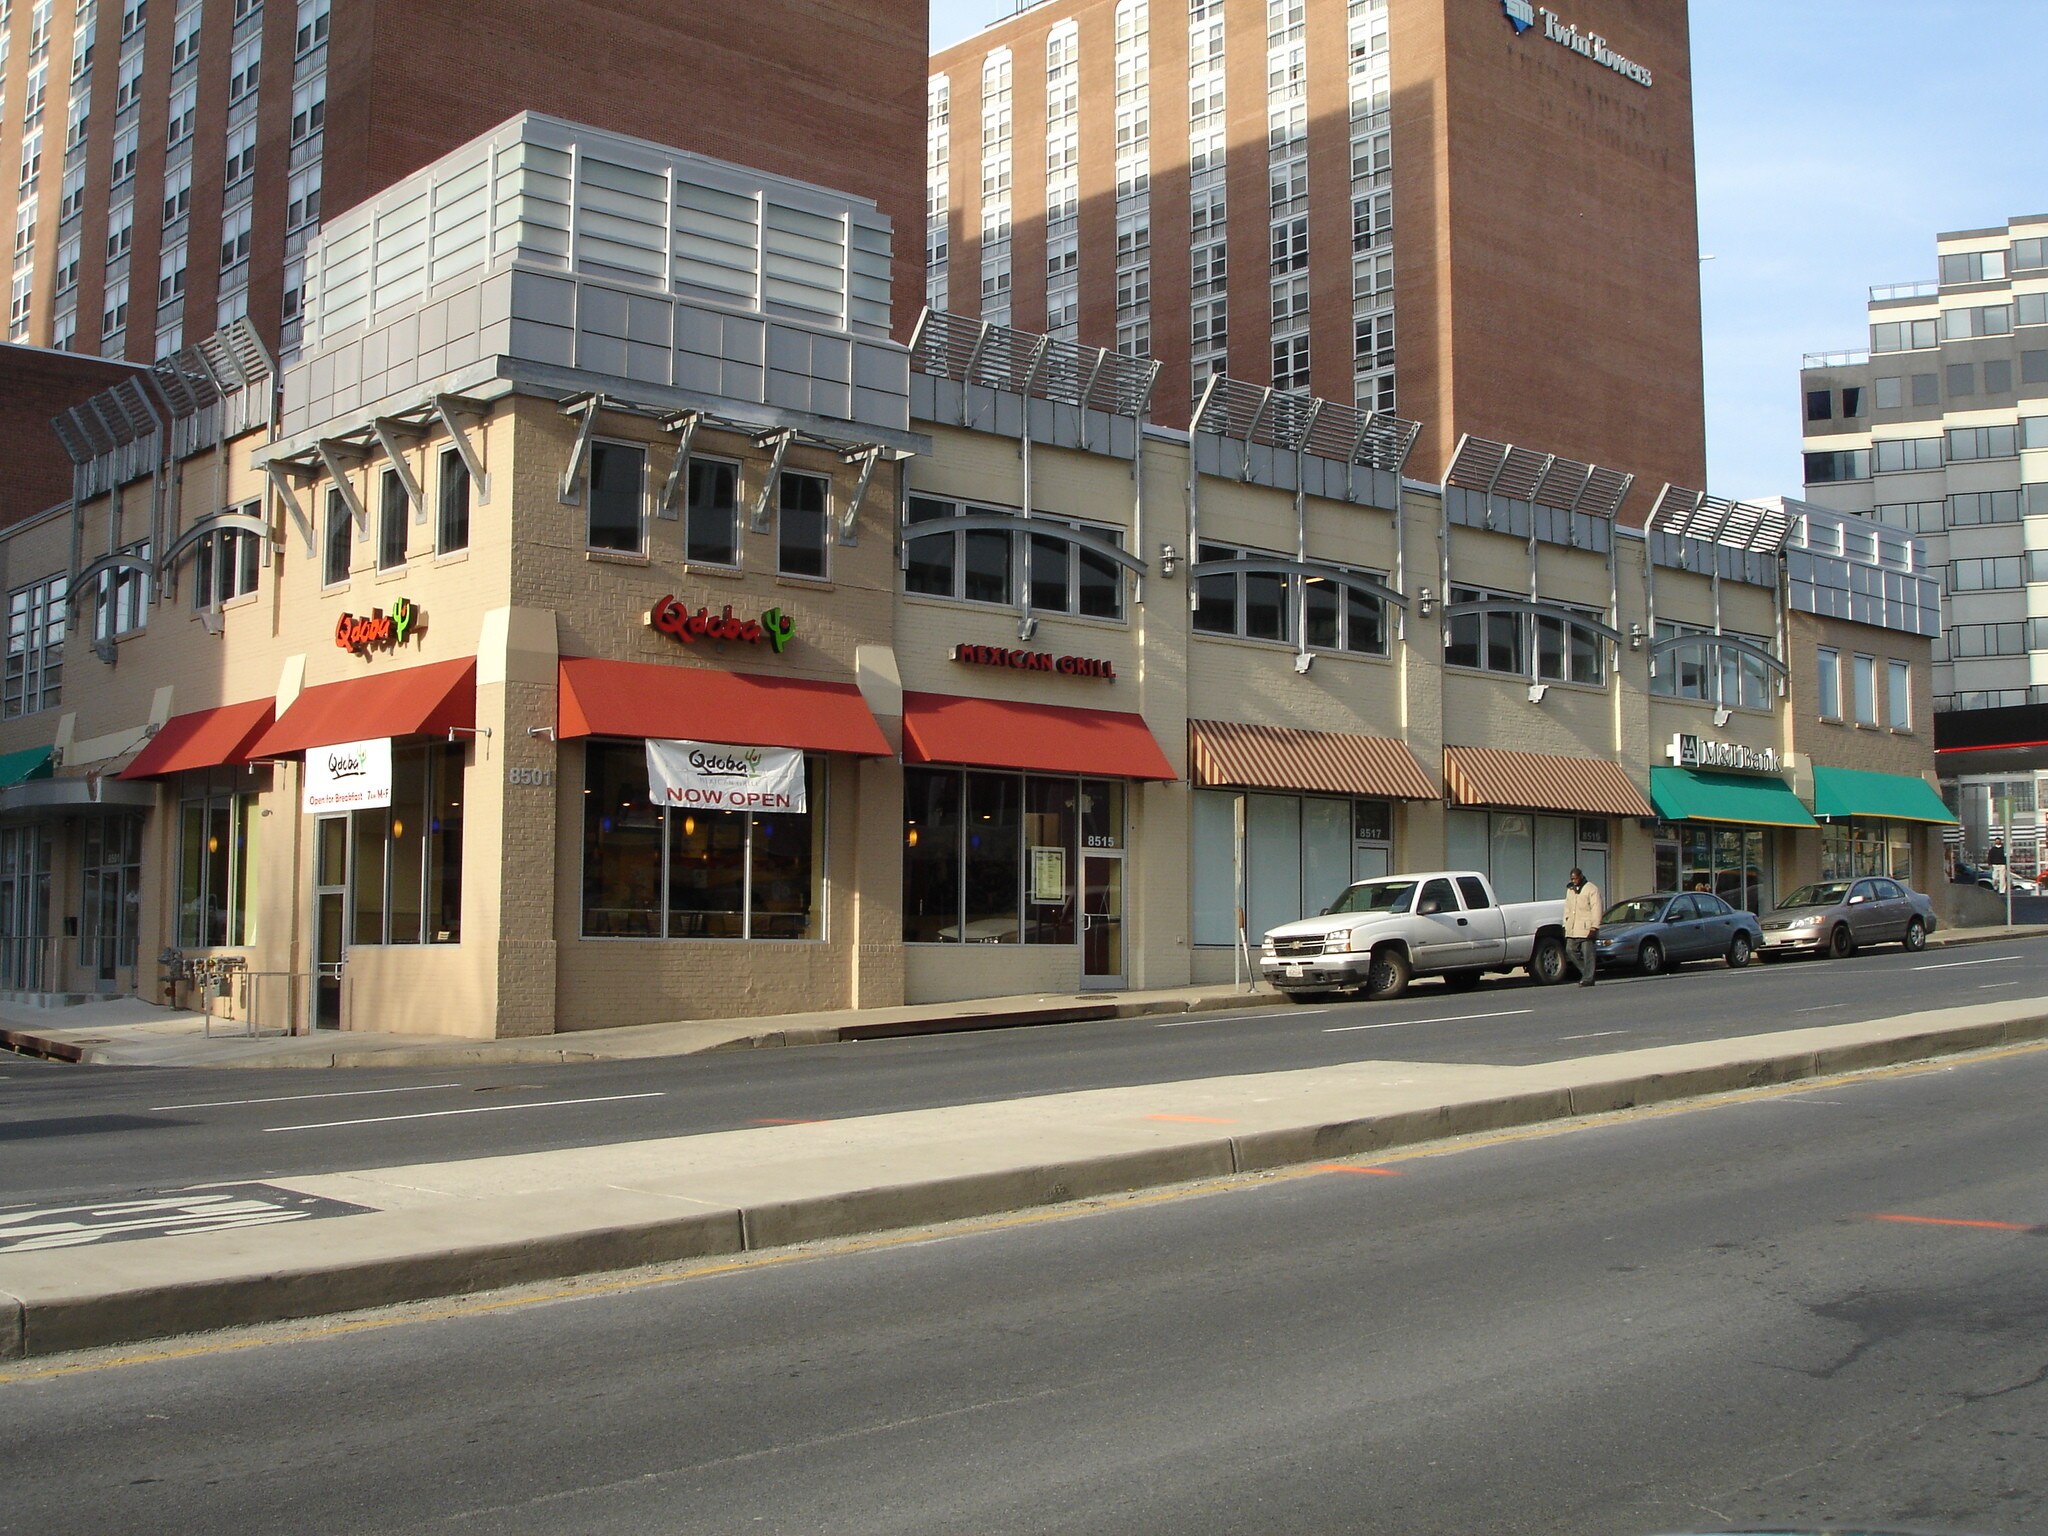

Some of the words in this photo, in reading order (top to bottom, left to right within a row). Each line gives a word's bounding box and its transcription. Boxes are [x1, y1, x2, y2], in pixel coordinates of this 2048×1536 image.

[1539, 7, 1592, 58] Twin
[1588, 31, 1652, 87] Towers
[335, 606, 393, 654] Qdoba
[651, 594, 762, 644] Qdoba
[957, 643, 1053, 671] MEXICAN
[1057, 655, 1117, 679] GRILL
[328, 752, 359, 777] Qdoba
[689, 749, 747, 774] Qdoba
[1738, 745, 1783, 773] Bank
[509, 767, 551, 786] 8501
[309, 795, 325, 806] Open
[335, 791, 363, 803] Breakfast
[666, 787, 723, 804] NOW
[729, 792, 790, 807] OPEN
[1088, 835, 1115, 847] 8515
[1360, 828, 1381, 839] 8517
